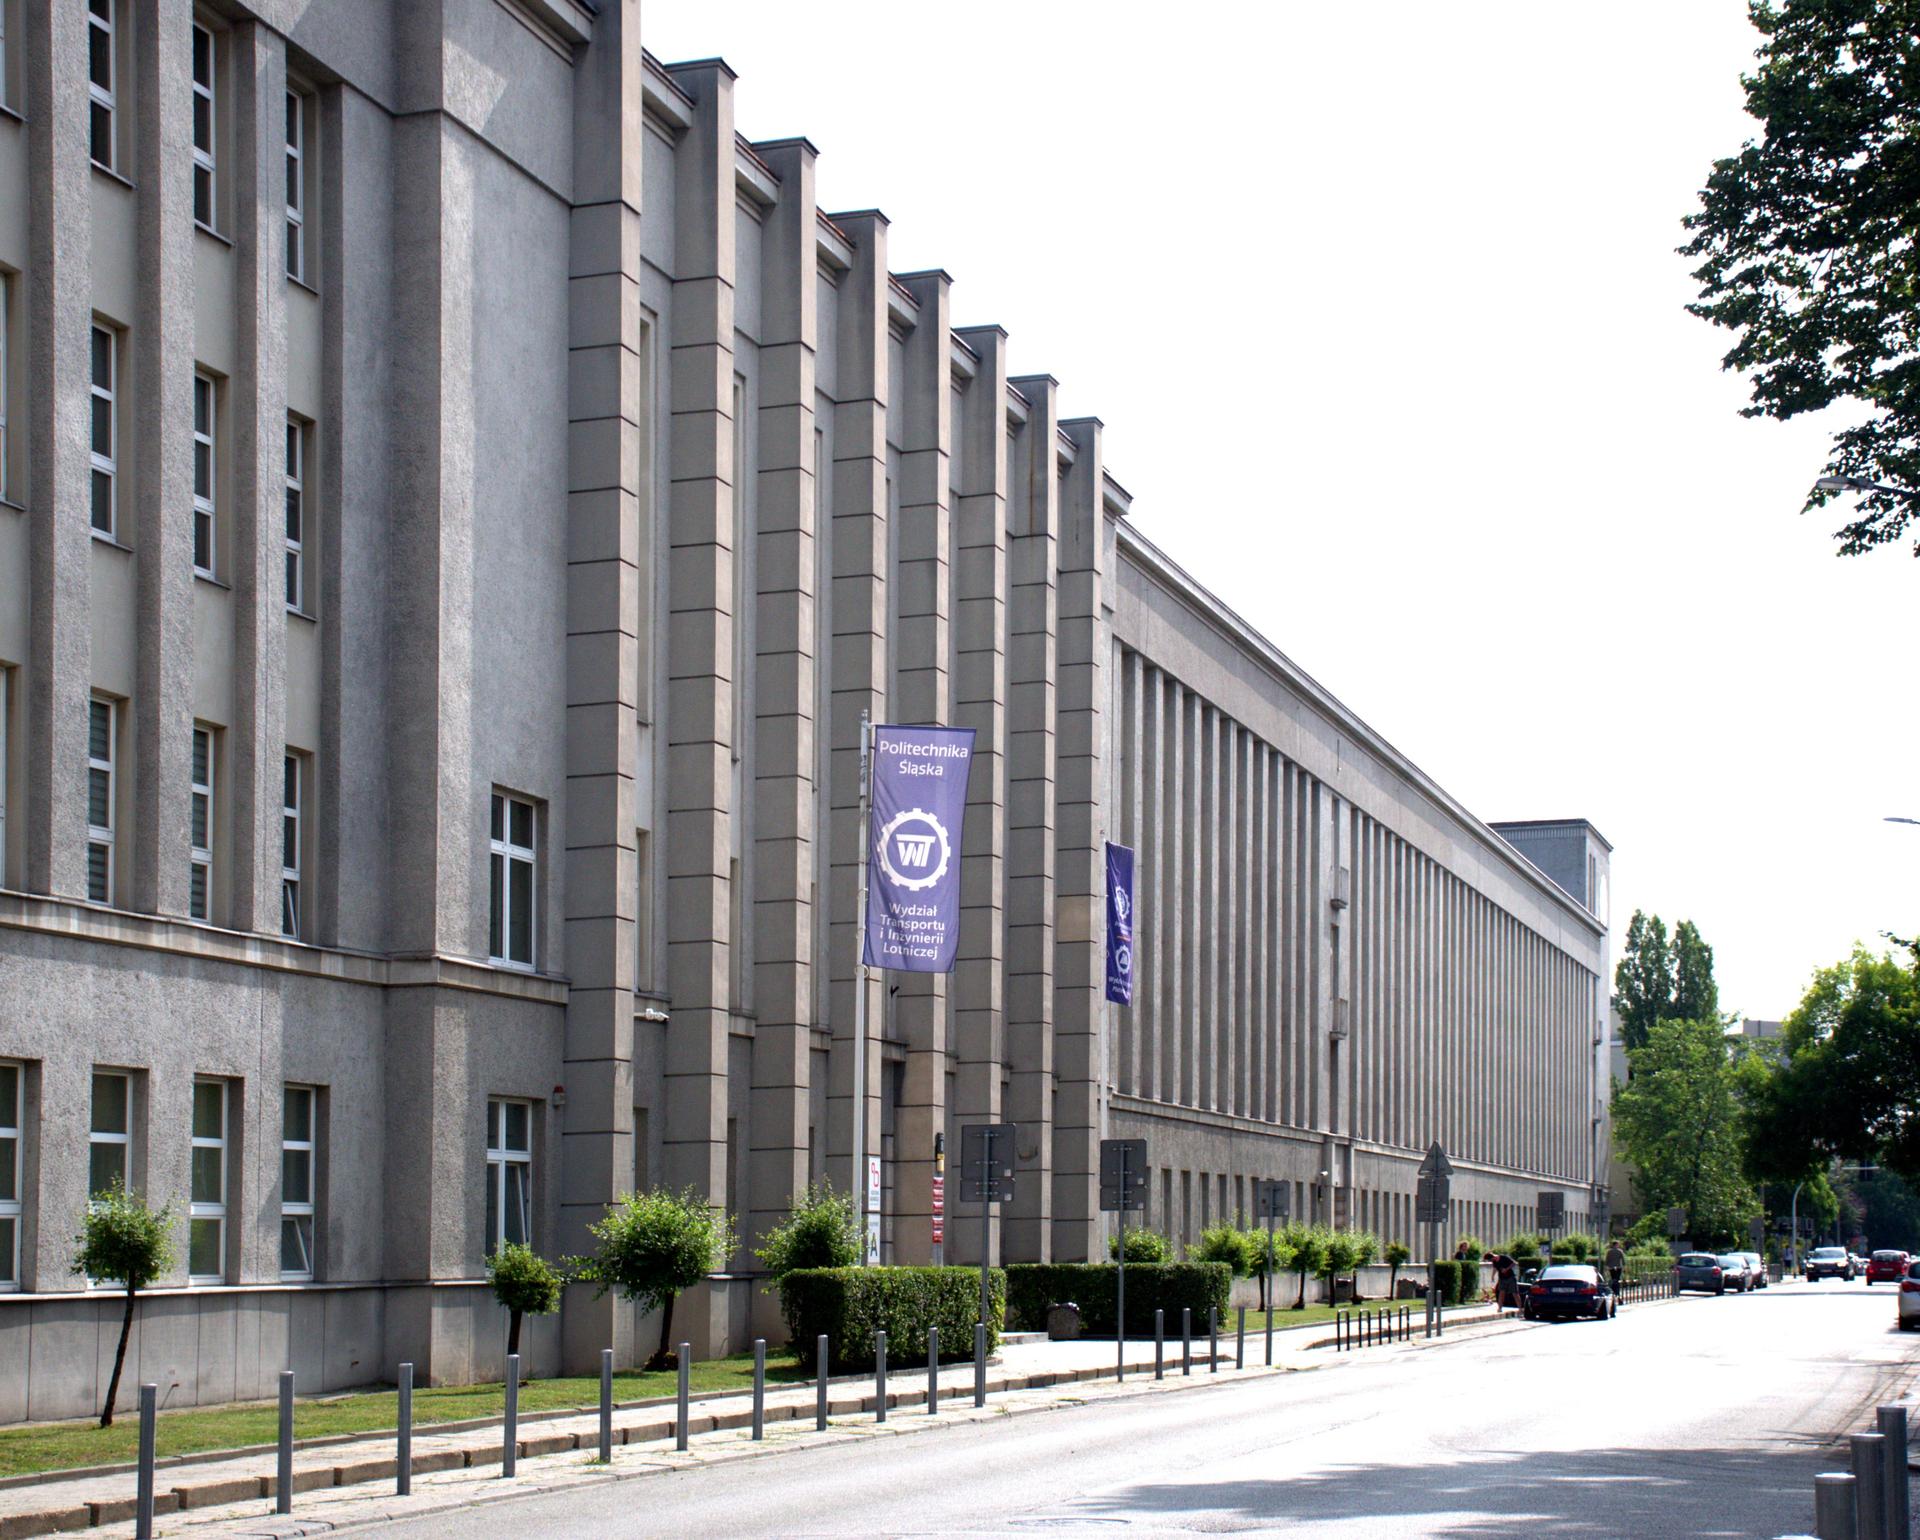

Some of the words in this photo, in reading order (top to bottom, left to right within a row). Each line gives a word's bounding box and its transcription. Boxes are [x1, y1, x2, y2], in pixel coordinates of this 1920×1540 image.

[880, 741, 968, 758] Politechnika
[899, 760, 944, 776] Śląska
[889, 903, 937, 917] Wydział
[880, 914, 945, 932] Transportu
[880, 928, 884, 939] i
[888, 929, 944, 944] Inżynierii
[883, 942, 938, 960] Lotniczej
